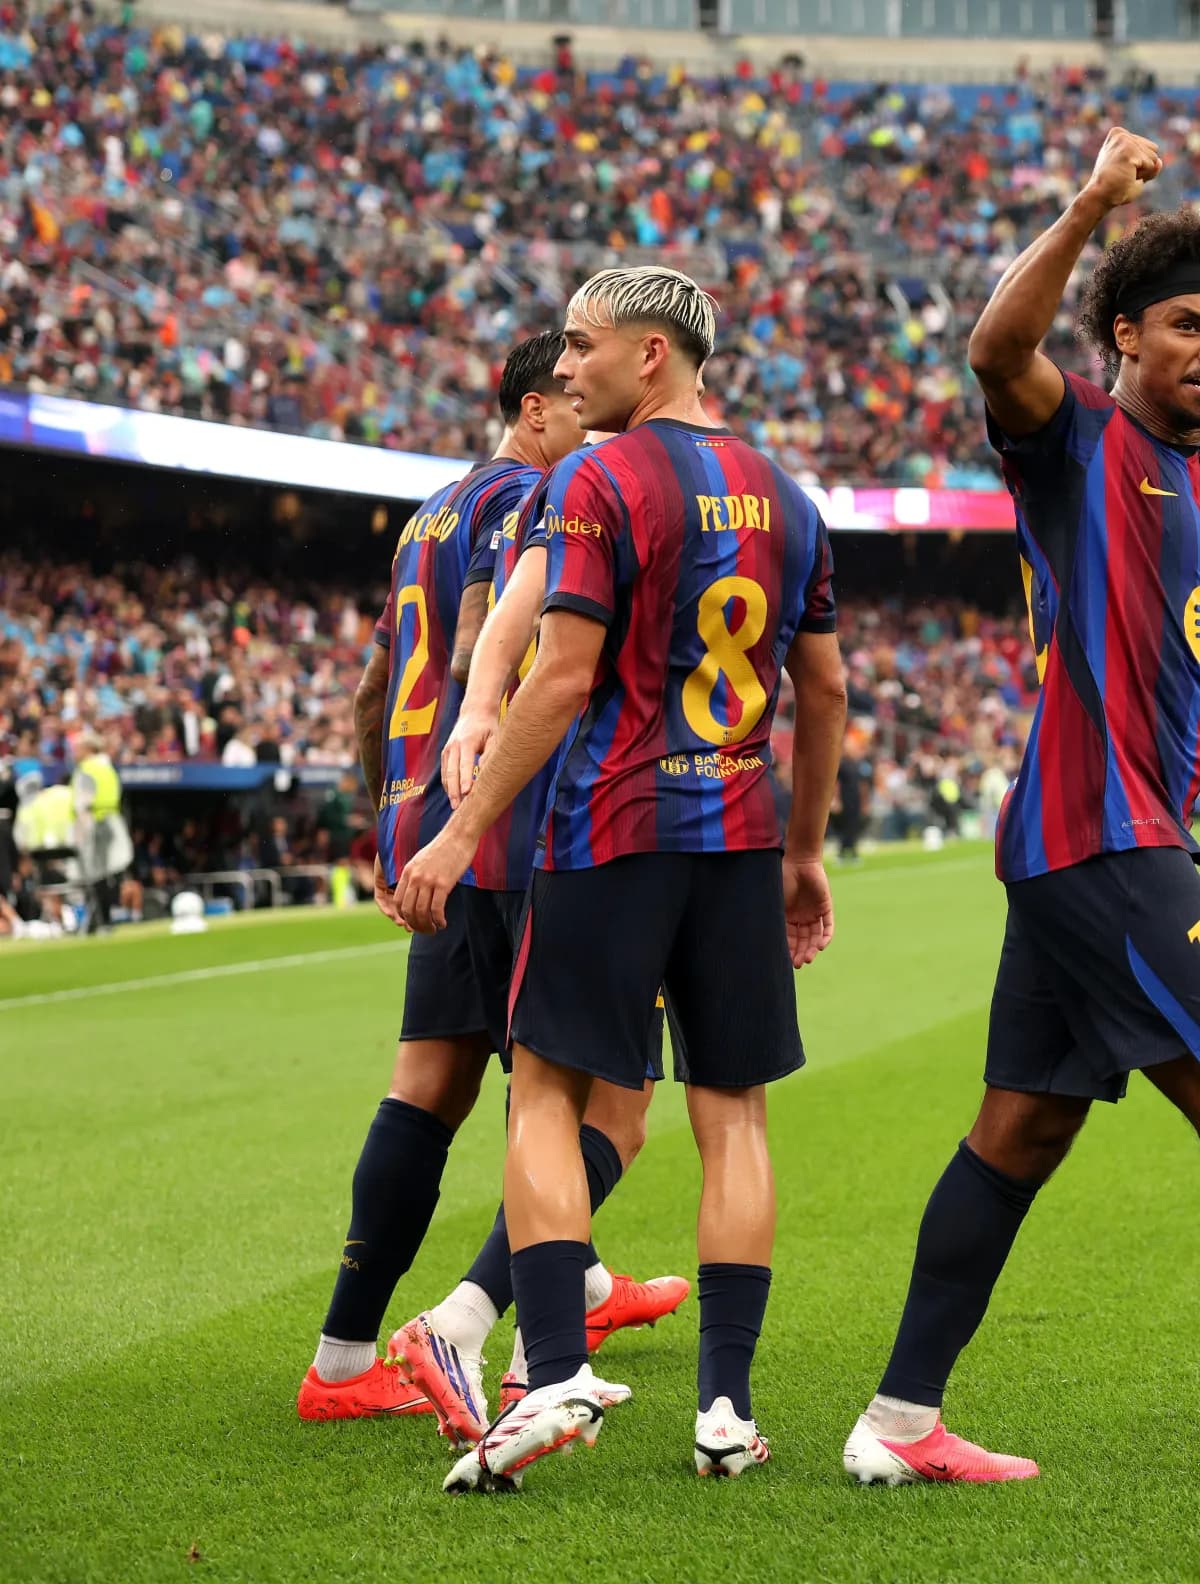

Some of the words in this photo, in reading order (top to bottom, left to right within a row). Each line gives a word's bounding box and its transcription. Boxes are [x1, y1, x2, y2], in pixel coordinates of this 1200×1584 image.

[544, 505, 603, 539] Midea
[696, 494, 770, 533] PEDRI
[388, 584, 439, 740] 2
[682, 576, 767, 746] 8
